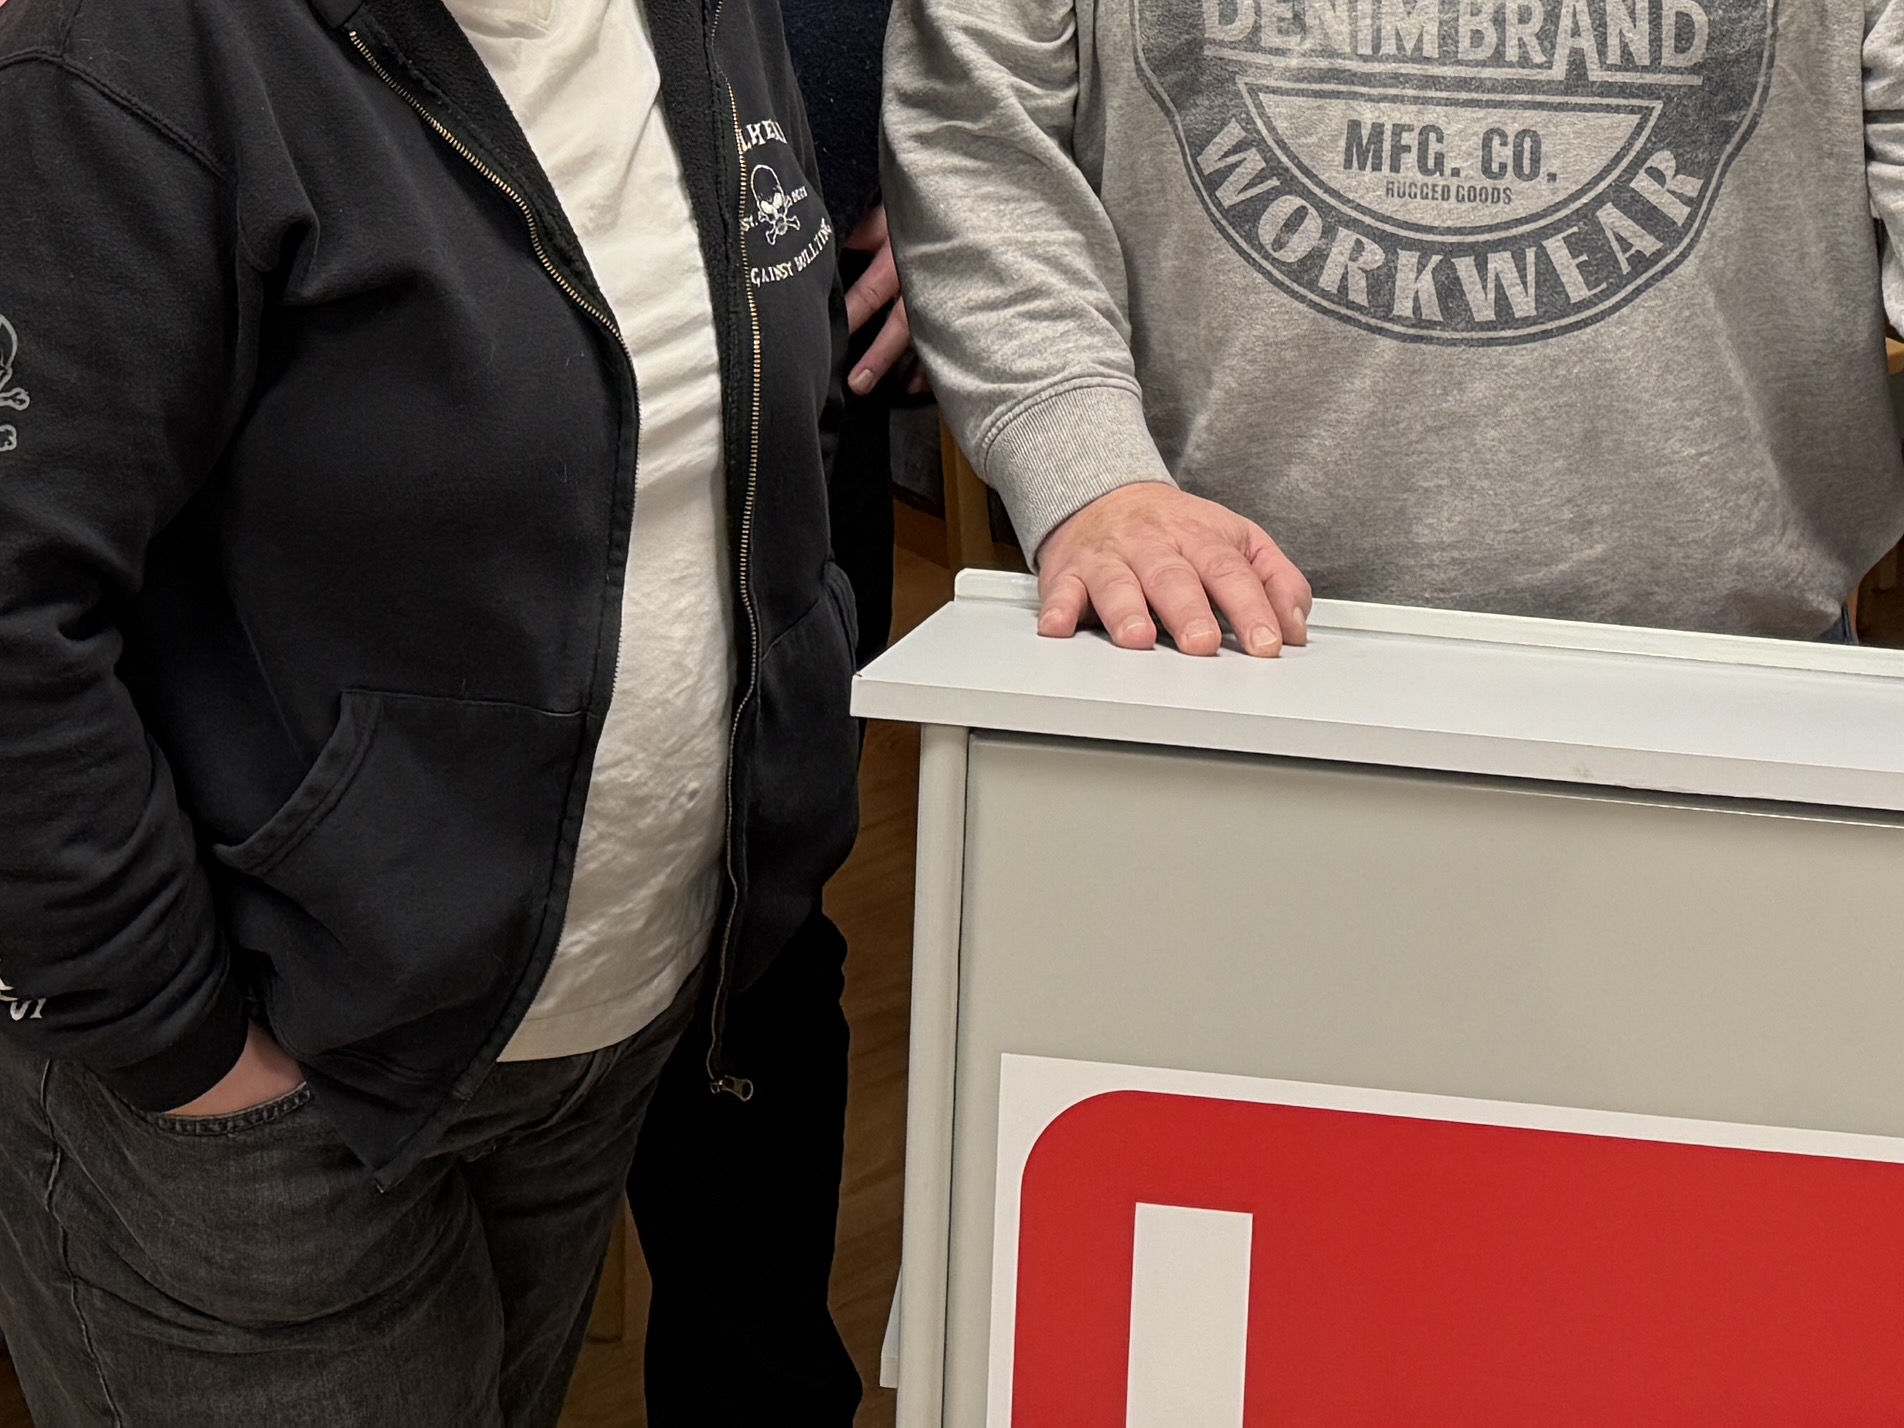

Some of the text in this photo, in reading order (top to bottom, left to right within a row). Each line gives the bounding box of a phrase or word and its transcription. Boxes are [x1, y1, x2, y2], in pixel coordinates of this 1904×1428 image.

[1343, 118, 1559, 183] MFG. CO.
[1195, 117, 1705, 323] WORKWEAR
[1385, 180, 1513, 205] RUGGED GOODS
